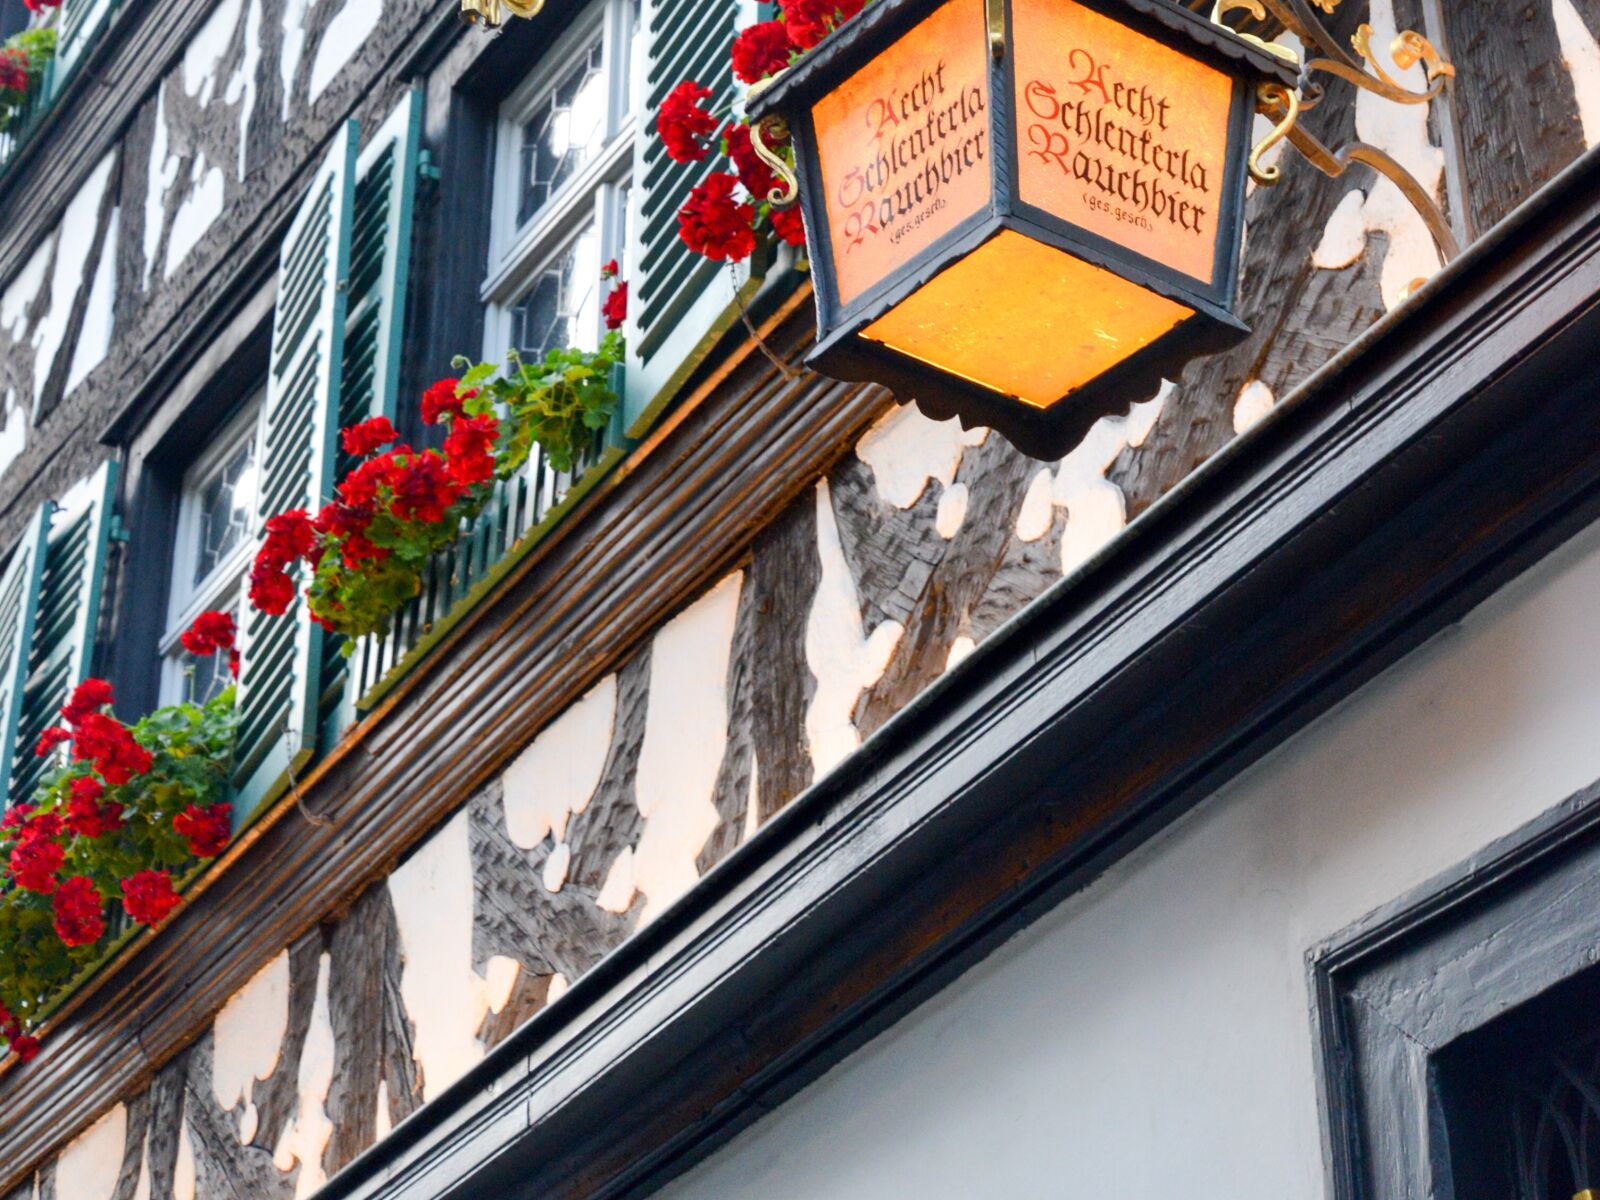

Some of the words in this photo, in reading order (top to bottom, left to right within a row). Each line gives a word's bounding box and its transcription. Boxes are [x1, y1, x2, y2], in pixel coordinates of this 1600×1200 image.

[838, 84, 985, 208] Schlenkerla
[866, 59, 946, 147] Aecht
[1024, 80, 1209, 193] Schlenkerla
[1068, 48, 1171, 132] Aecht
[844, 130, 985, 254] Rauchbier
[1027, 123, 1206, 236] Rauchbier
